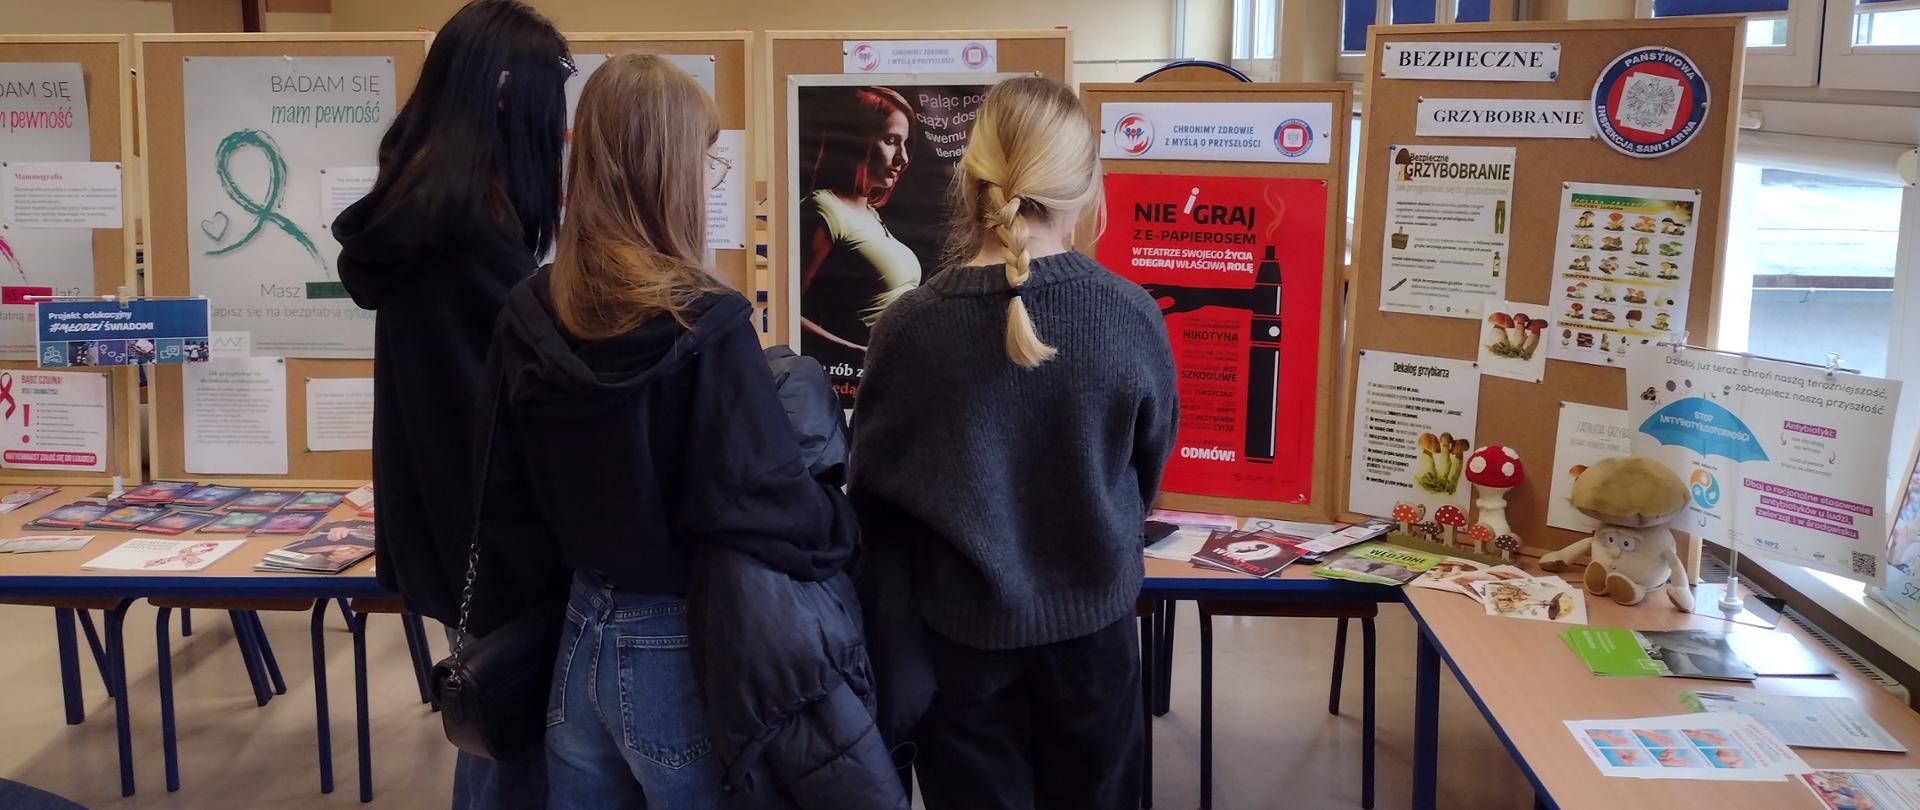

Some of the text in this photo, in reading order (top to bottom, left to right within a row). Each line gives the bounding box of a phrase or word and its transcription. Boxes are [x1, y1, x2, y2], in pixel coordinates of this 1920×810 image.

[1398, 51, 1543, 68] BEZPIECZNE
[1624, 52, 1696, 80] PAŃSTWOWA
[41, 81, 71, 101] SIĘ
[271, 75, 380, 96] BADAM SIĘ
[919, 94, 959, 110] Paląc
[10, 106, 73, 133] pewność
[271, 100, 380, 128] mam pewność
[916, 113, 949, 130] ciąży
[1433, 109, 1584, 125] GRZYBOBRANIE
[1173, 125, 1254, 135] CHRONIMY ZDROWIE
[1597, 105, 1697, 153] INSPEKCJA SANITARNA
[1165, 136, 1261, 149] Z MYŚLĄ O PRZYSZŁOŚCI
[1410, 153, 1449, 163] Bezpieczne
[1404, 162, 1511, 180] GRZYBOBRANIE
[1134, 203, 1177, 223] NIE
[1133, 229, 1256, 245] Z E-PAPIEROSEM
[1132, 247, 1253, 260] W TEATRZE SWOJEGO ŻYCIA
[1131, 258, 1254, 274] ODEGRAJ WŁAŚCIWĄ ROLĘ
[260, 283, 300, 298] Masz
[48, 310, 132, 320] Projekt edukacyjny
[211, 306, 242, 319] apisz
[266, 308, 280, 317] na
[104, 321, 153, 331] ŚWIADOMI
[1183, 329, 1239, 342] NIKOTYNA
[829, 363, 853, 376] rób
[1181, 370, 1237, 382] SZKODLIWE
[1393, 361, 1450, 378] Dekalog grzybiarza
[1666, 355, 1695, 370] Działaj
[1742, 368, 1772, 380] chroń
[1774, 374, 1804, 388] naszą
[1735, 383, 1884, 415] zabezpiecz naszą przyszłość
[1694, 411, 1714, 422] STOP
[1180, 446, 1236, 462] ODMÓW!
[1745, 479, 1764, 492] Dbaj
[1772, 487, 1818, 503] racjonalne
[1820, 497, 1871, 514] stosowanie
[1762, 497, 1817, 516] antybiotyków
